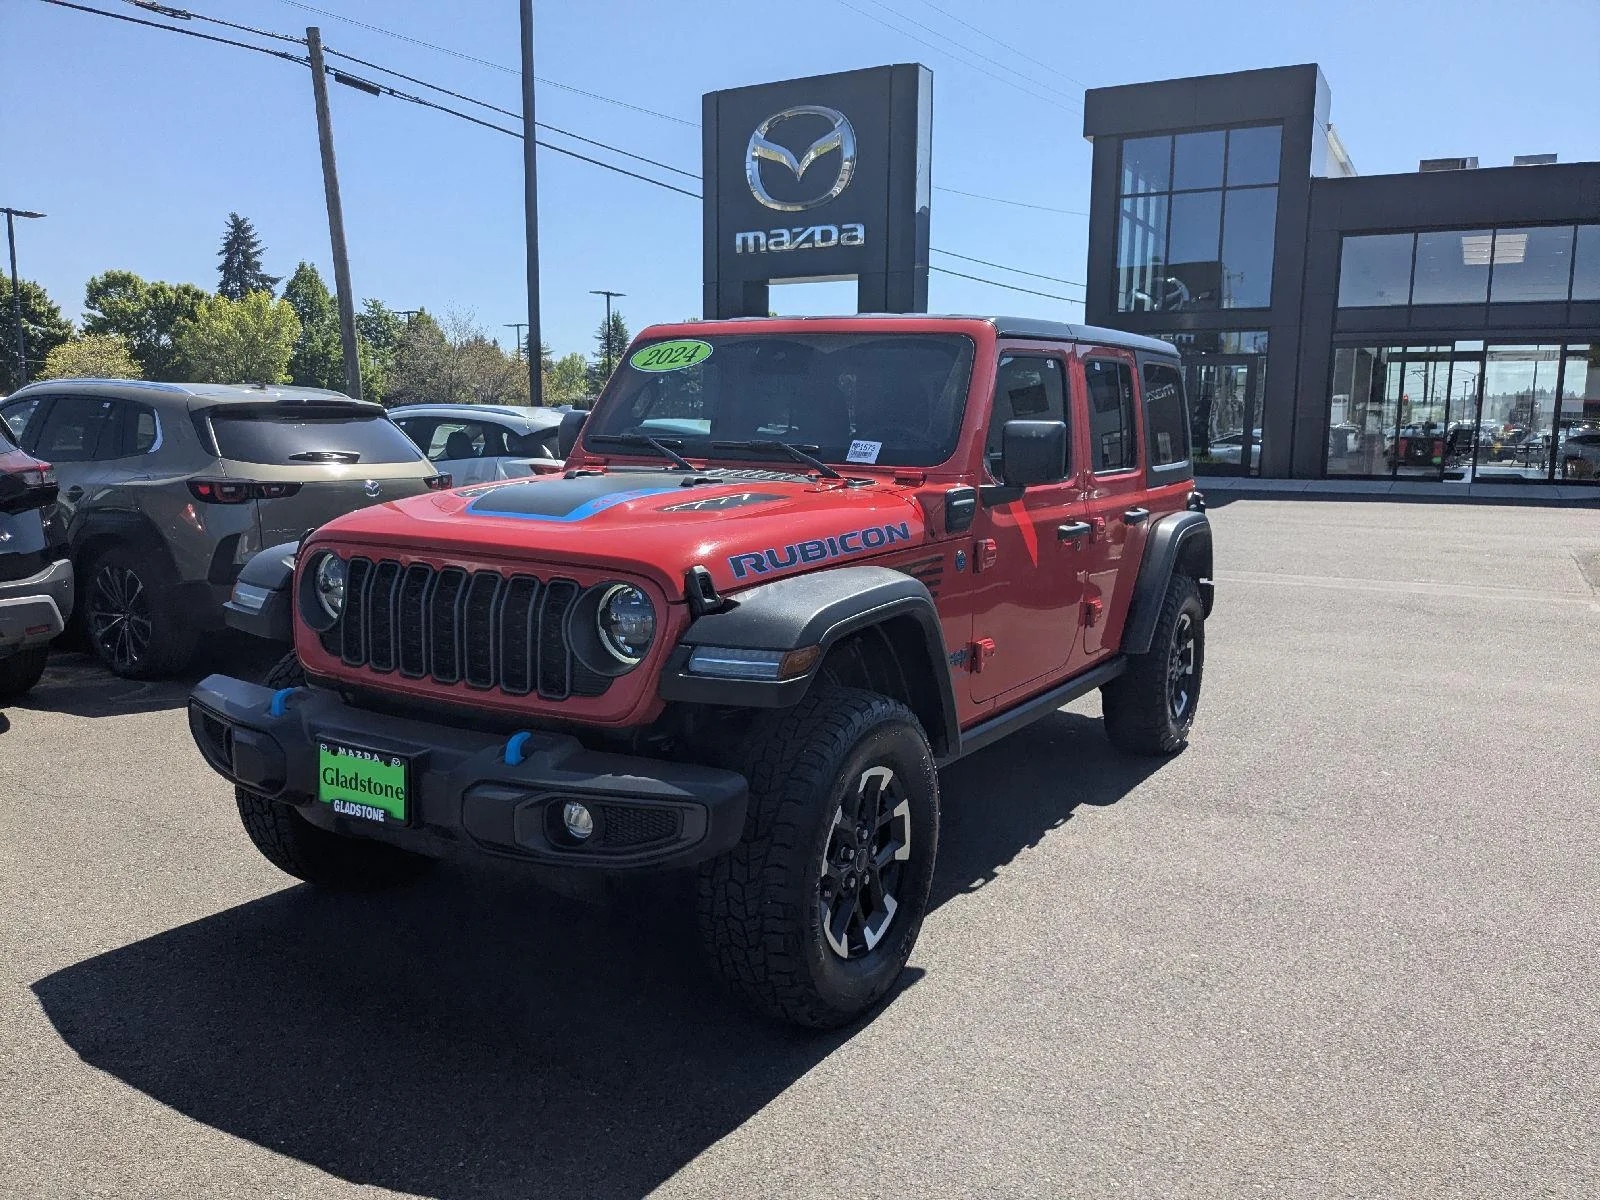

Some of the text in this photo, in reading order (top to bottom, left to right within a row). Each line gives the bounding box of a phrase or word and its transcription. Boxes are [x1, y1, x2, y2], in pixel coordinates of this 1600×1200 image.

[736, 223, 865, 253] mazda
[641, 344, 701, 367] 2024
[728, 520, 912, 580] RUBICON
[338, 746, 380, 763] MAZDA
[322, 766, 404, 801] Gladstone
[333, 799, 385, 822] GLADSTONE
